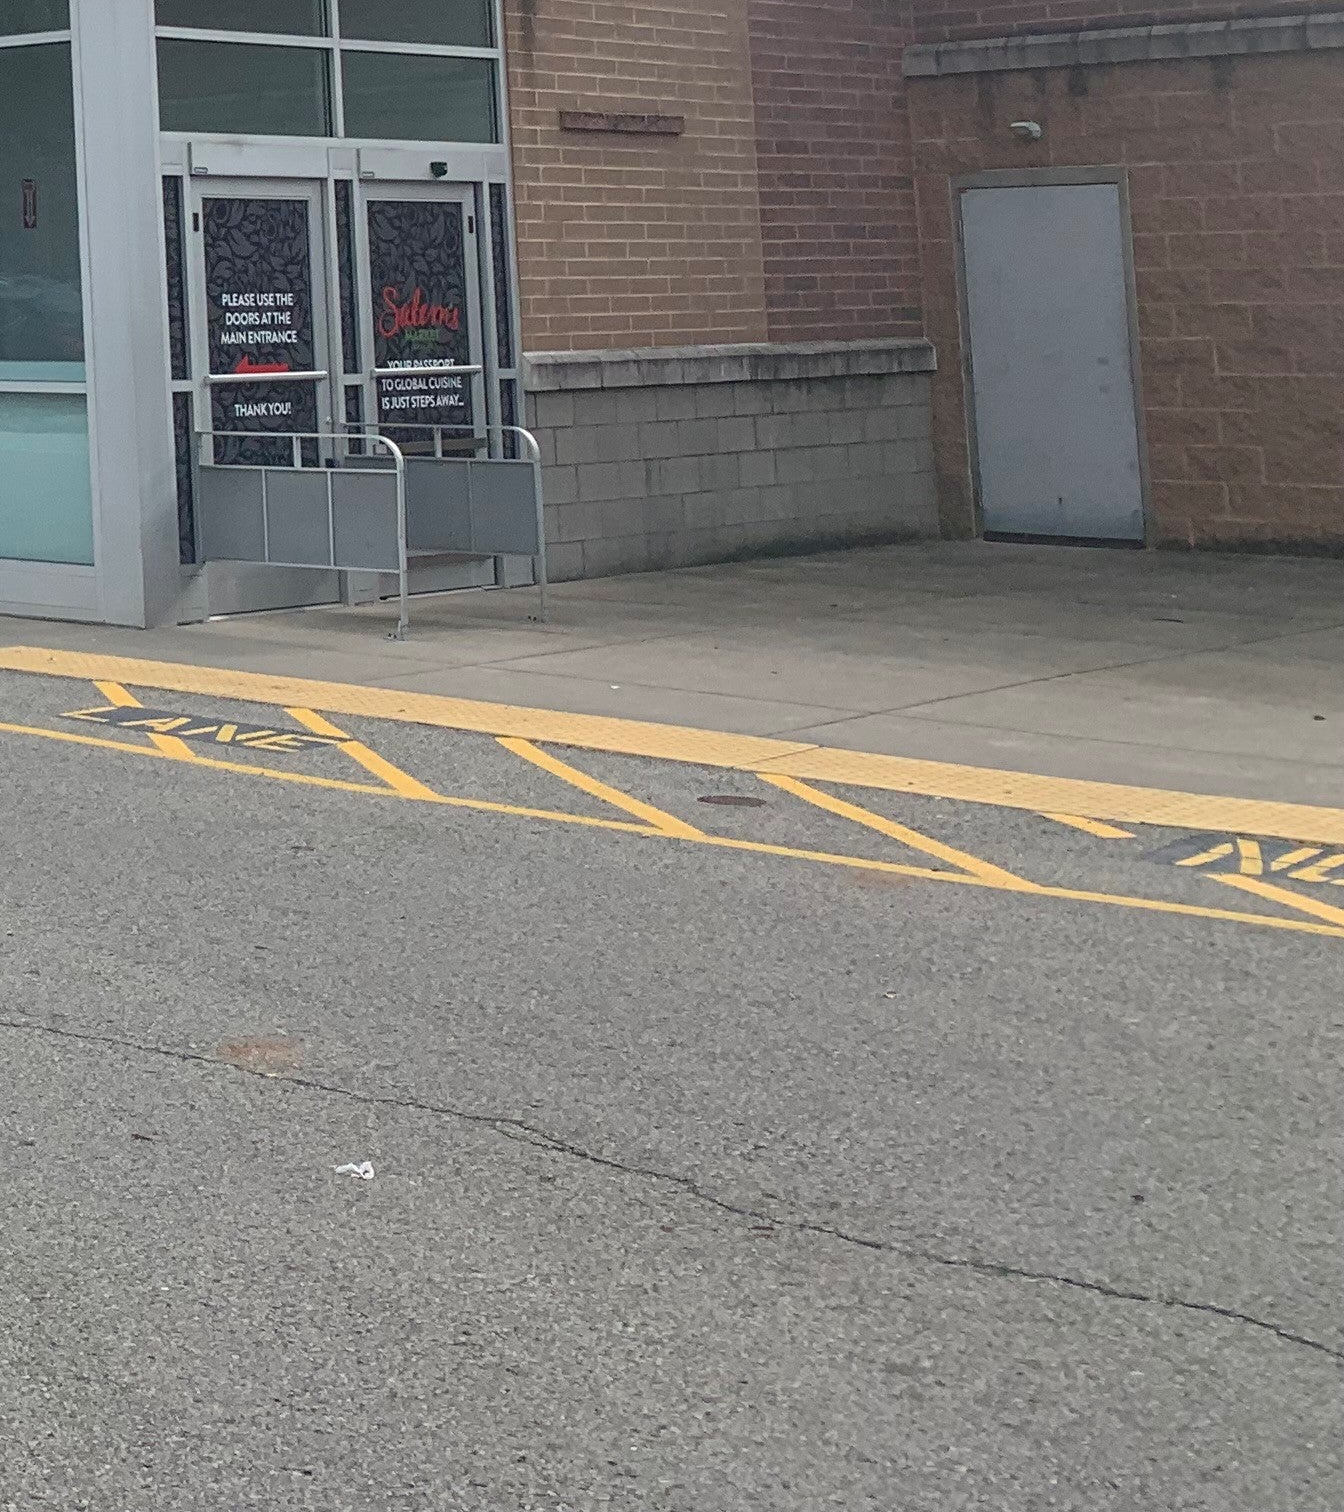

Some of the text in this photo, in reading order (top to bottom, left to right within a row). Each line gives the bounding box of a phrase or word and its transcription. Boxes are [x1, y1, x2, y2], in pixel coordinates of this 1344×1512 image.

[221, 292, 294, 307] PLEASE USE THE
[225, 311, 292, 325] DOORS AT THE
[220, 330, 298, 345] MAIN ENTRANCE
[387, 360, 412, 369] YOUR
[381, 376, 463, 391] TO GLOBAL CUISINE
[234, 402, 292, 417] THANK YOU!
[381, 397, 390, 409] IS
[390, 395, 411, 409] JUST
[411, 395, 436, 408] STEPS
[59, 705, 340, 753] LANE
